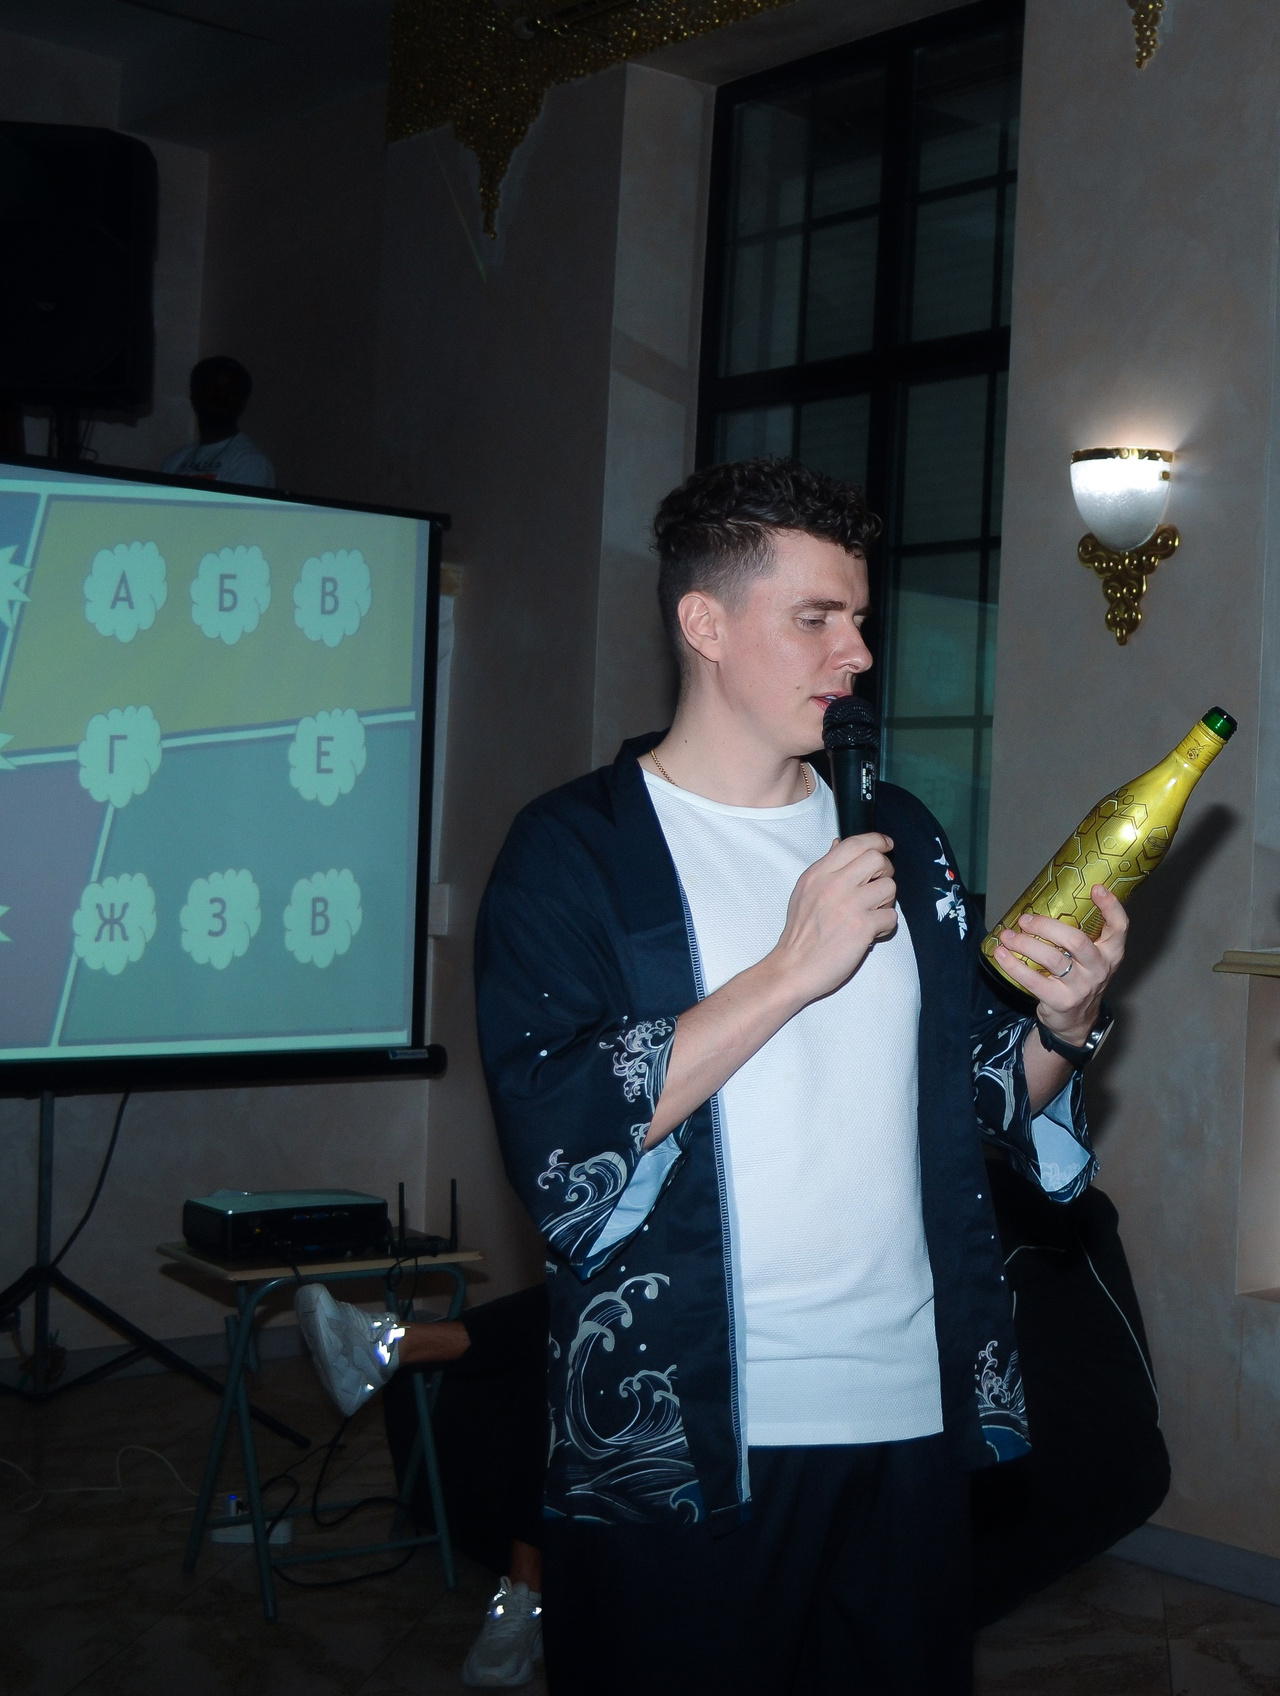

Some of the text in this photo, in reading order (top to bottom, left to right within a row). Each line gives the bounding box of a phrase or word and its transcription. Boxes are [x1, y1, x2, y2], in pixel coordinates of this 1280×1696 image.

[110, 570, 340, 616] А Б В
[108, 734, 335, 775] Г Е
[94, 896, 331, 943] Ж З В
